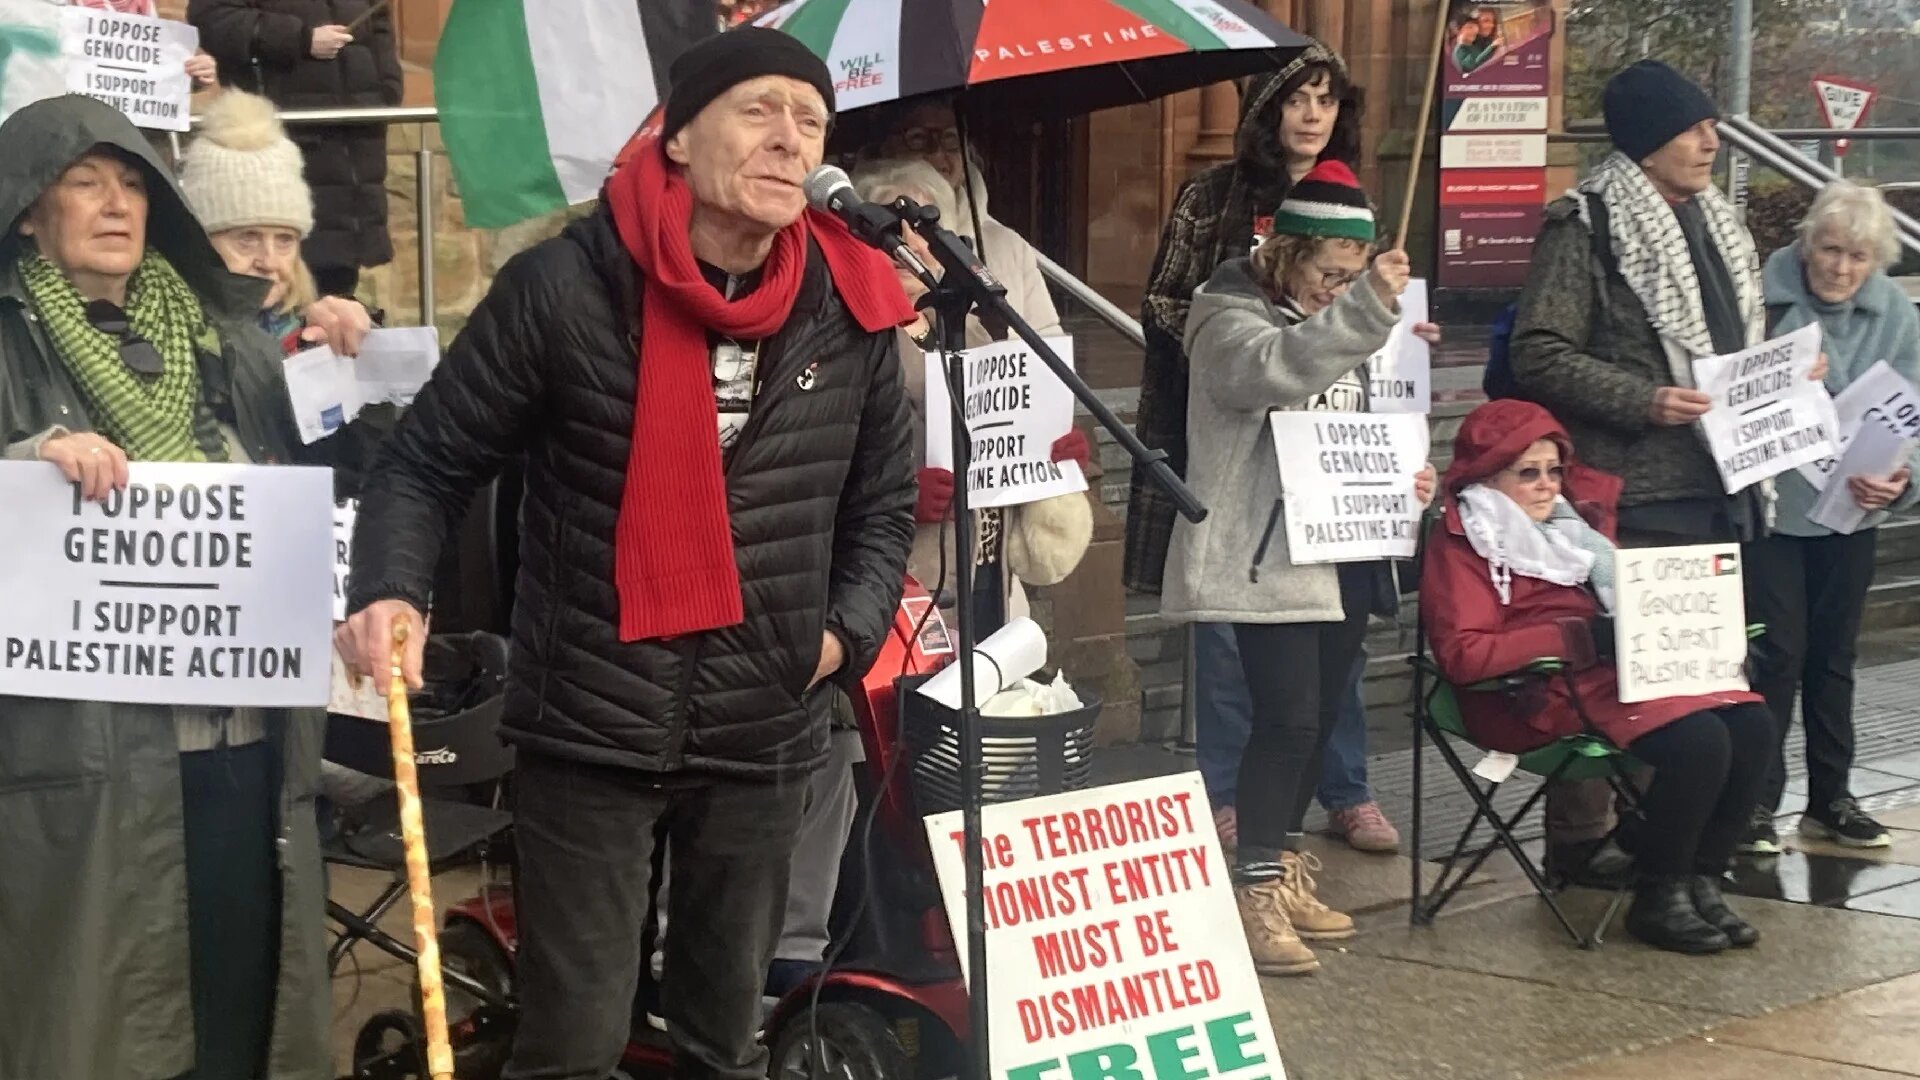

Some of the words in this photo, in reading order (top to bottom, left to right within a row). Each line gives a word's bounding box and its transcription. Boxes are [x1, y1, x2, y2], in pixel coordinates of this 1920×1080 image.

[87, 17, 93, 34] I
[100, 19, 161, 42] OPPOSE
[975, 24, 1158, 61] PALESTINE
[84, 39, 161, 65] GENOCIDE
[840, 53, 884, 70] WILL
[87, 73, 92, 88] I
[95, 74, 156, 95] SUPPORT
[834, 73, 883, 93] FREE
[848, 66, 871, 79] BE
[133, 101, 178, 119] ACTION
[1825, 86, 1861, 107] GIVE
[976, 353, 1027, 386] OPPOSE
[1741, 341, 1794, 377] OPPOSE
[1370, 380, 1415, 398] CTION
[1728, 367, 1793, 407] GENOCIDE
[966, 385, 1030, 421] GENOCIDE
[1315, 423, 1324, 444] I
[1327, 423, 1392, 446] OPPOSE
[1741, 408, 1793, 443] SUPPORT
[971, 434, 1025, 463] UPPORT
[1320, 450, 1402, 474] GENOCIDE
[1000, 460, 1063, 488] ACTION
[72, 481, 82, 515] I
[101, 483, 245, 521] OPPOSE
[1332, 496, 1339, 516] I
[1344, 494, 1408, 515] SUPPORT
[1305, 520, 1388, 544] PALESTINE
[64, 527, 252, 568] GENOCIDE
[1626, 560, 1644, 583] I
[1653, 557, 1712, 580] OPPOSE
[1639, 589, 1720, 617] GENOCIDE
[72, 599, 81, 631] I
[94, 601, 241, 636] SUPPORT
[1630, 633, 1647, 653] I
[5, 637, 174, 677] PALESTINE
[187, 647, 301, 679] ACTION
[1629, 659, 1700, 688] PALESTINE
[414, 751, 457, 764] areCo
[1023, 792, 1195, 861] TERRORIST
[963, 867, 1092, 931] IONIST
[1103, 846, 1212, 905] ENTITY
[1032, 919, 1124, 979] MUST
[1134, 910, 1179, 957] BE
[1016, 959, 1221, 1044] DISMANTLED
